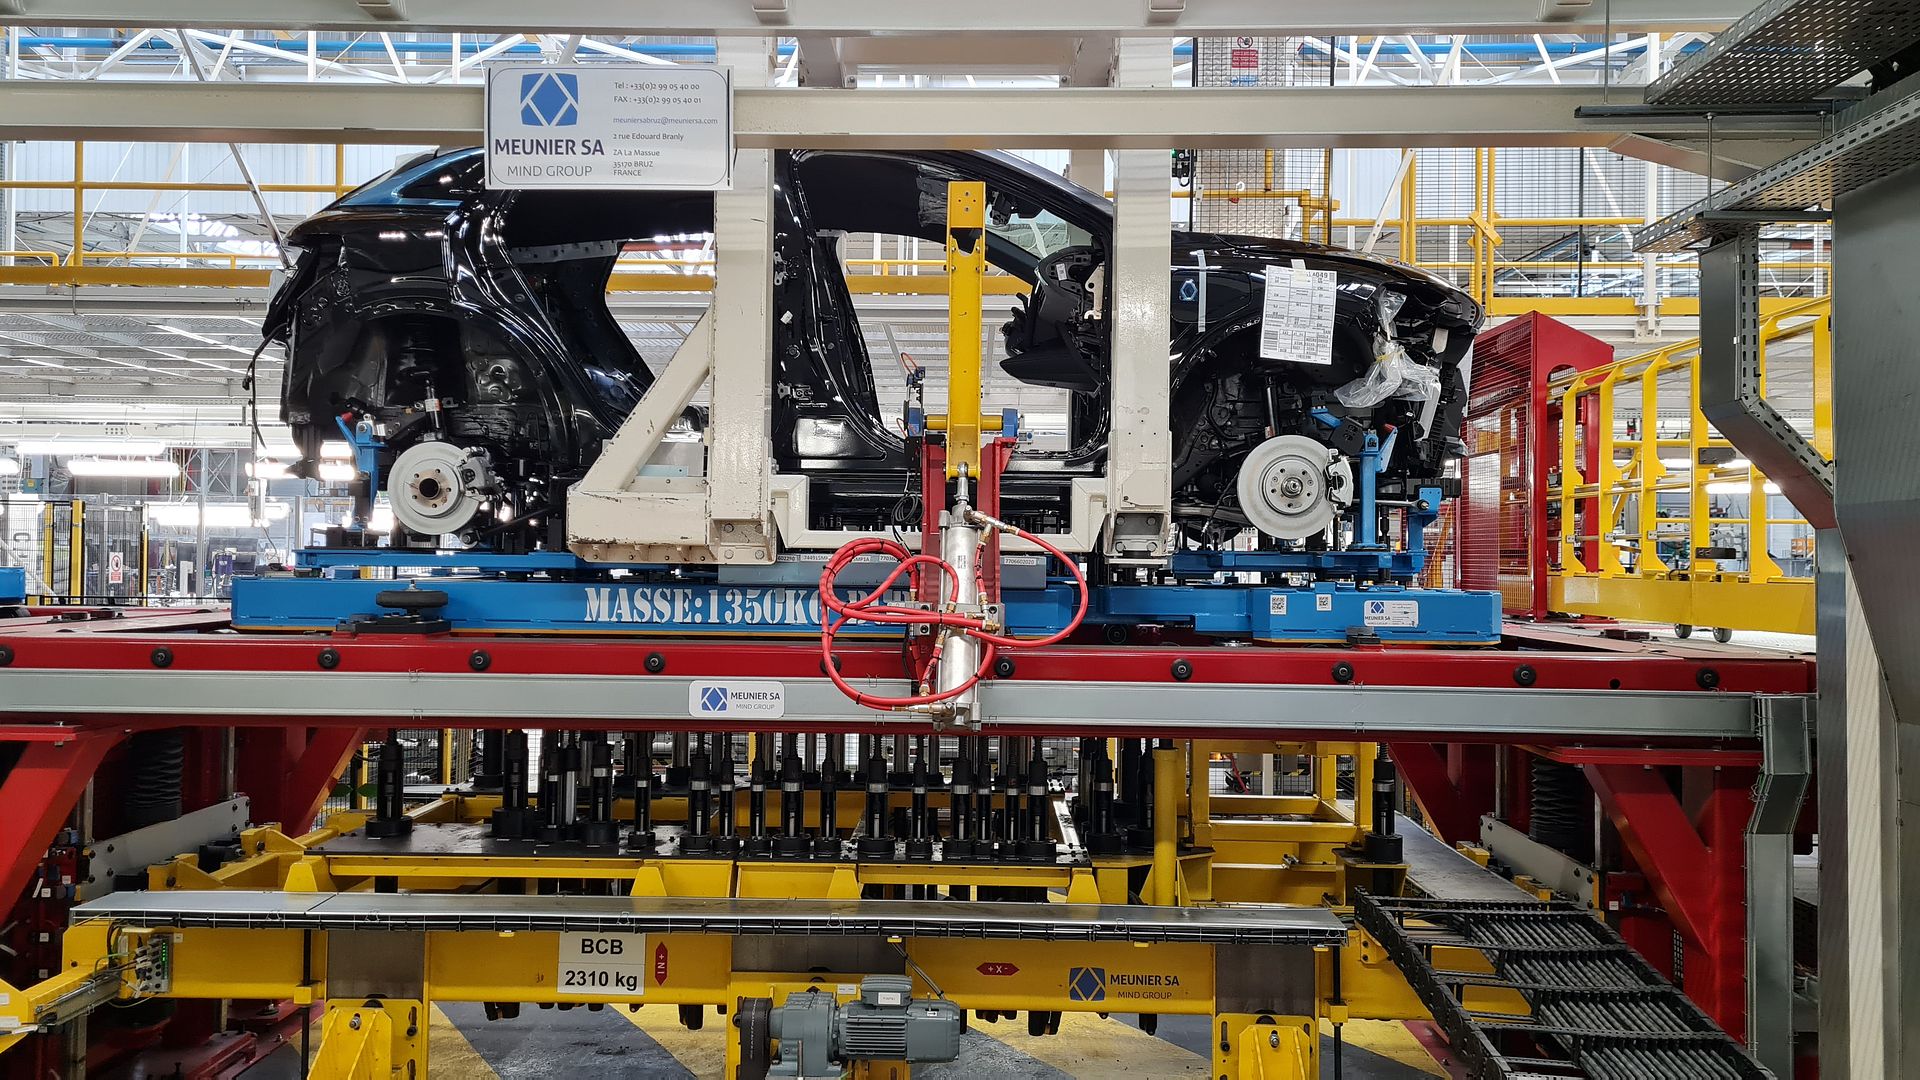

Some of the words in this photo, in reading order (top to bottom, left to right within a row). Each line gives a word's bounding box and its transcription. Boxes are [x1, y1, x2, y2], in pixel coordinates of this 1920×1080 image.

[630, 82, 657, 91] +33(0)2
[633, 95, 660, 104] +33(0)2
[613, 116, 718, 125] meuniersabruz@meuniersa.com
[632, 132, 661, 140] Edouard
[662, 132, 684, 141] Branly
[494, 139, 576, 156] MEUNIER
[581, 139, 605, 156] SA
[507, 166, 542, 176] MIND
[546, 166, 593, 176] GROUP
[730, 692, 768, 700] MEUNIER
[770, 692, 781, 701] SA
[581, 938, 624, 955] BCB
[564, 970, 609, 987] 2310
[615, 971, 638, 992] kg
[1110, 974, 1162, 985] MEUNIER
[1165, 975, 1180, 986] SA
[1118, 991, 1140, 999] MIND
[1142, 991, 1172, 999] GROUP
